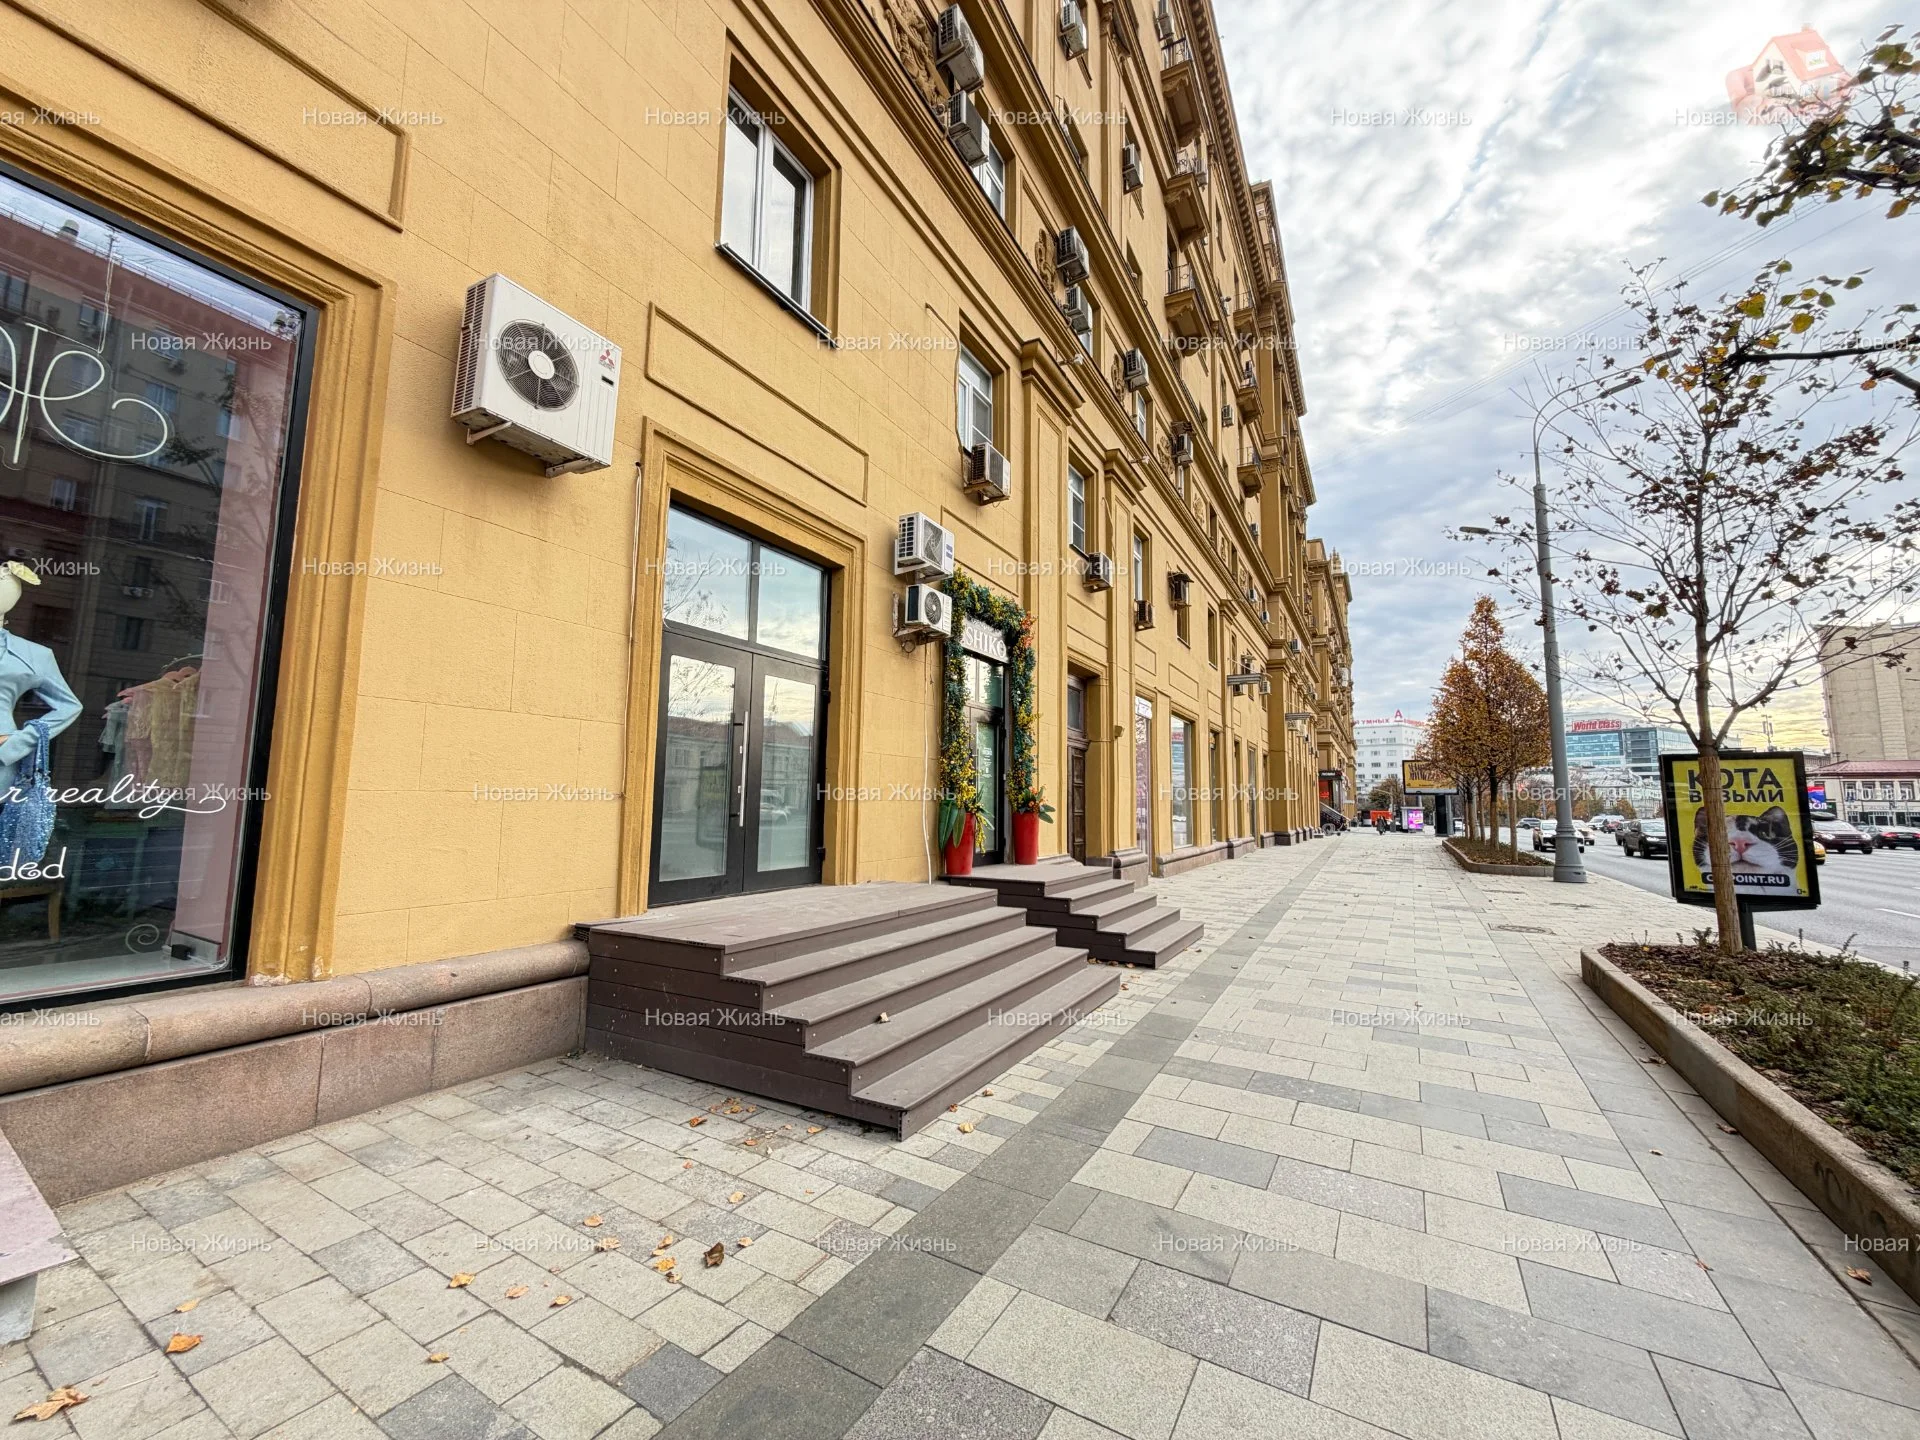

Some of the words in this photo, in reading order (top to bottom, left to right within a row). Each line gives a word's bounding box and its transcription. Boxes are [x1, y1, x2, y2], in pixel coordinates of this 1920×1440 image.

[1573, 720, 1597, 731] World
[1598, 720, 1621, 729] Class
[44, 773, 227, 819] reality
[1689, 789, 1785, 803] ВЗЬМИ
[1706, 874, 1785, 884] COINT.RU
